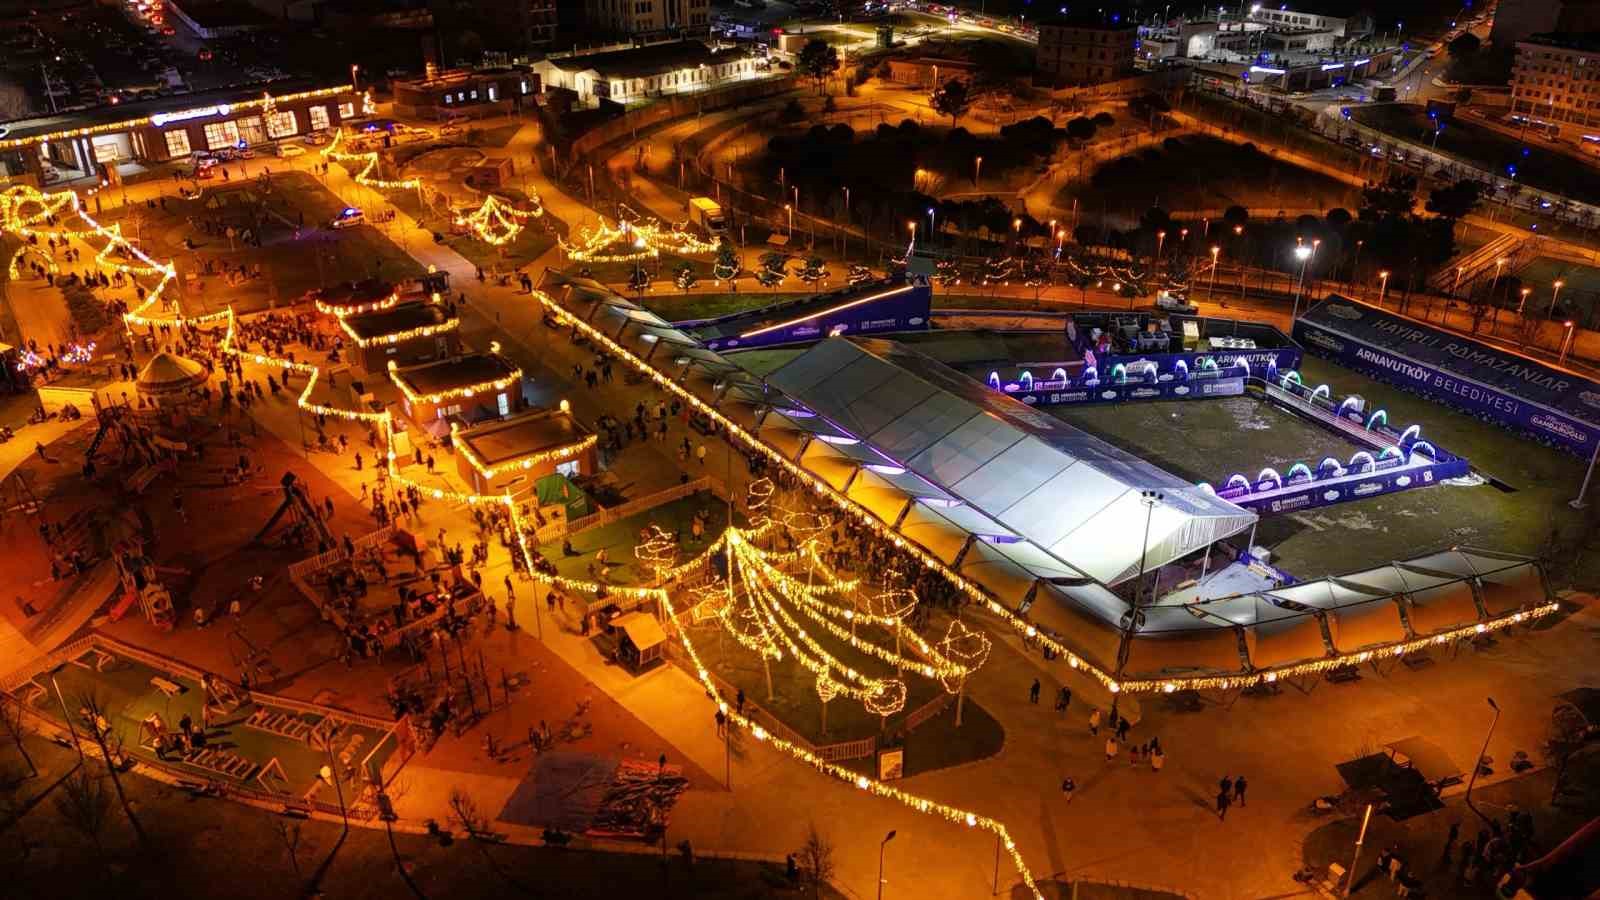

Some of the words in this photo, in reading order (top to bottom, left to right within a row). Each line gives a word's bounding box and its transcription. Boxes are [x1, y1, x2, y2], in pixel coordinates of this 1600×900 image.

[1356, 348, 1431, 381] ARNAVUTKÖY
[1434, 376, 1519, 416] BELEDİYESİ
[1442, 343, 1569, 392] RAMAZANLAR
